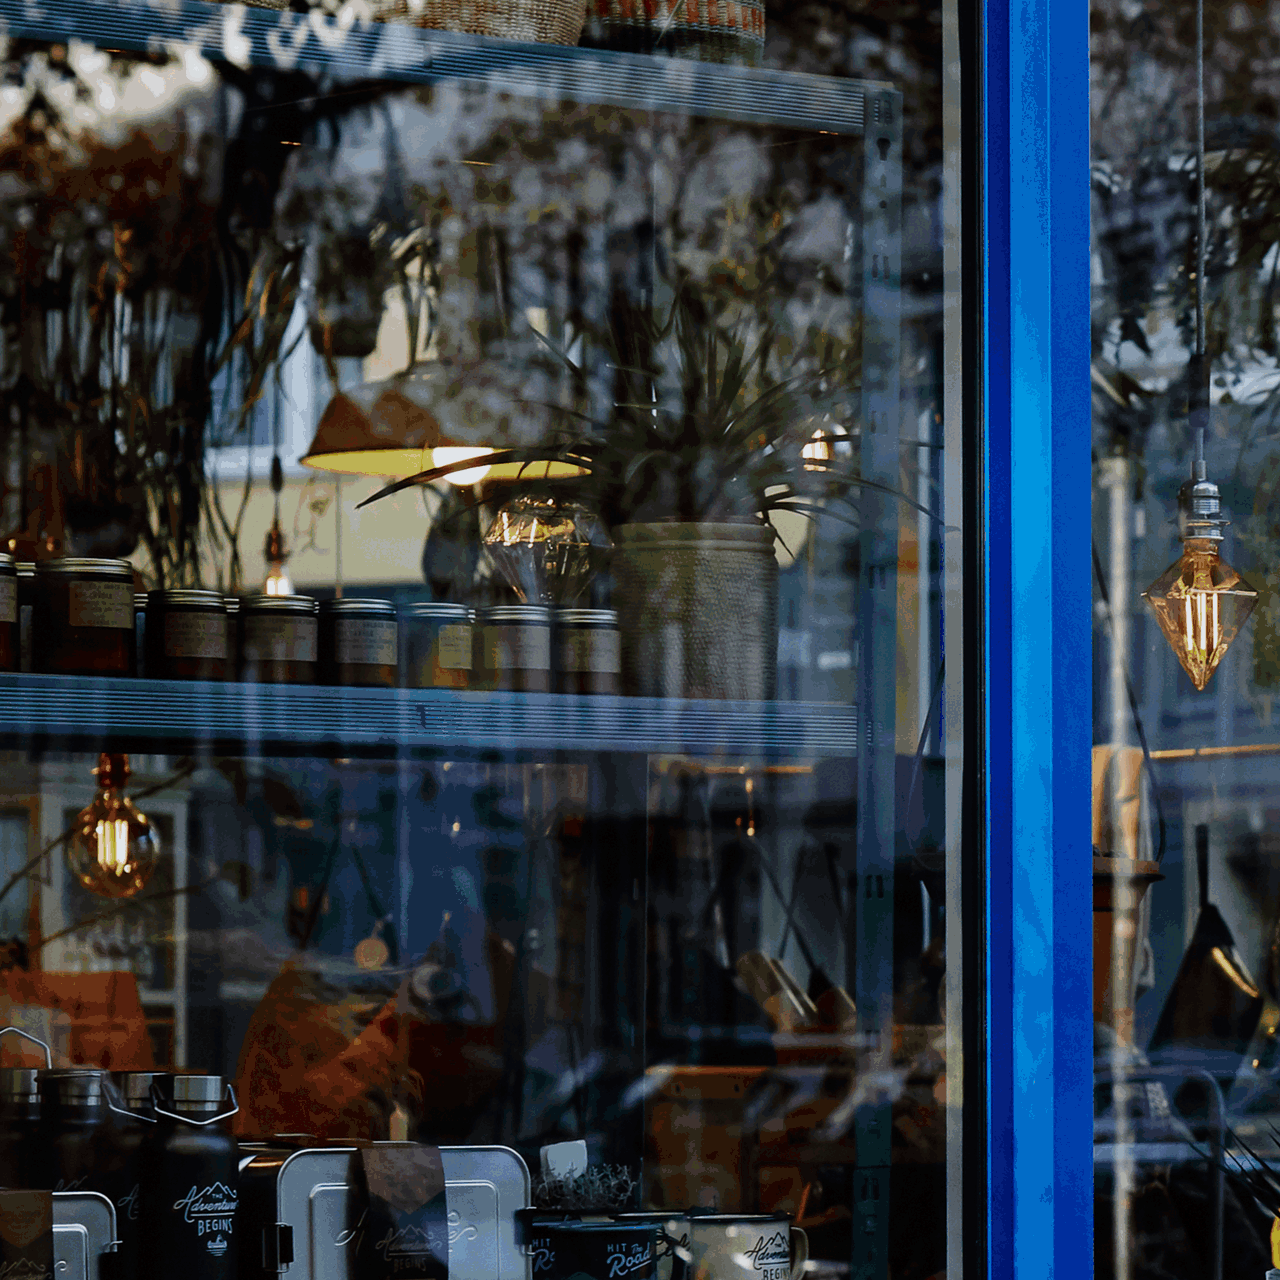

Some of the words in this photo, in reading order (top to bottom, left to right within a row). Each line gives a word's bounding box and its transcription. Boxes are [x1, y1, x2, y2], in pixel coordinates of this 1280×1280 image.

[197, 1217, 233, 1237] BEGINS
[531, 1238, 551, 1247] HIT
[606, 1243, 628, 1253] HIT
[606, 1241, 652, 1279] Road
[744, 1236, 790, 1271] Advent
[392, 1257, 427, 1274] BEGINS
